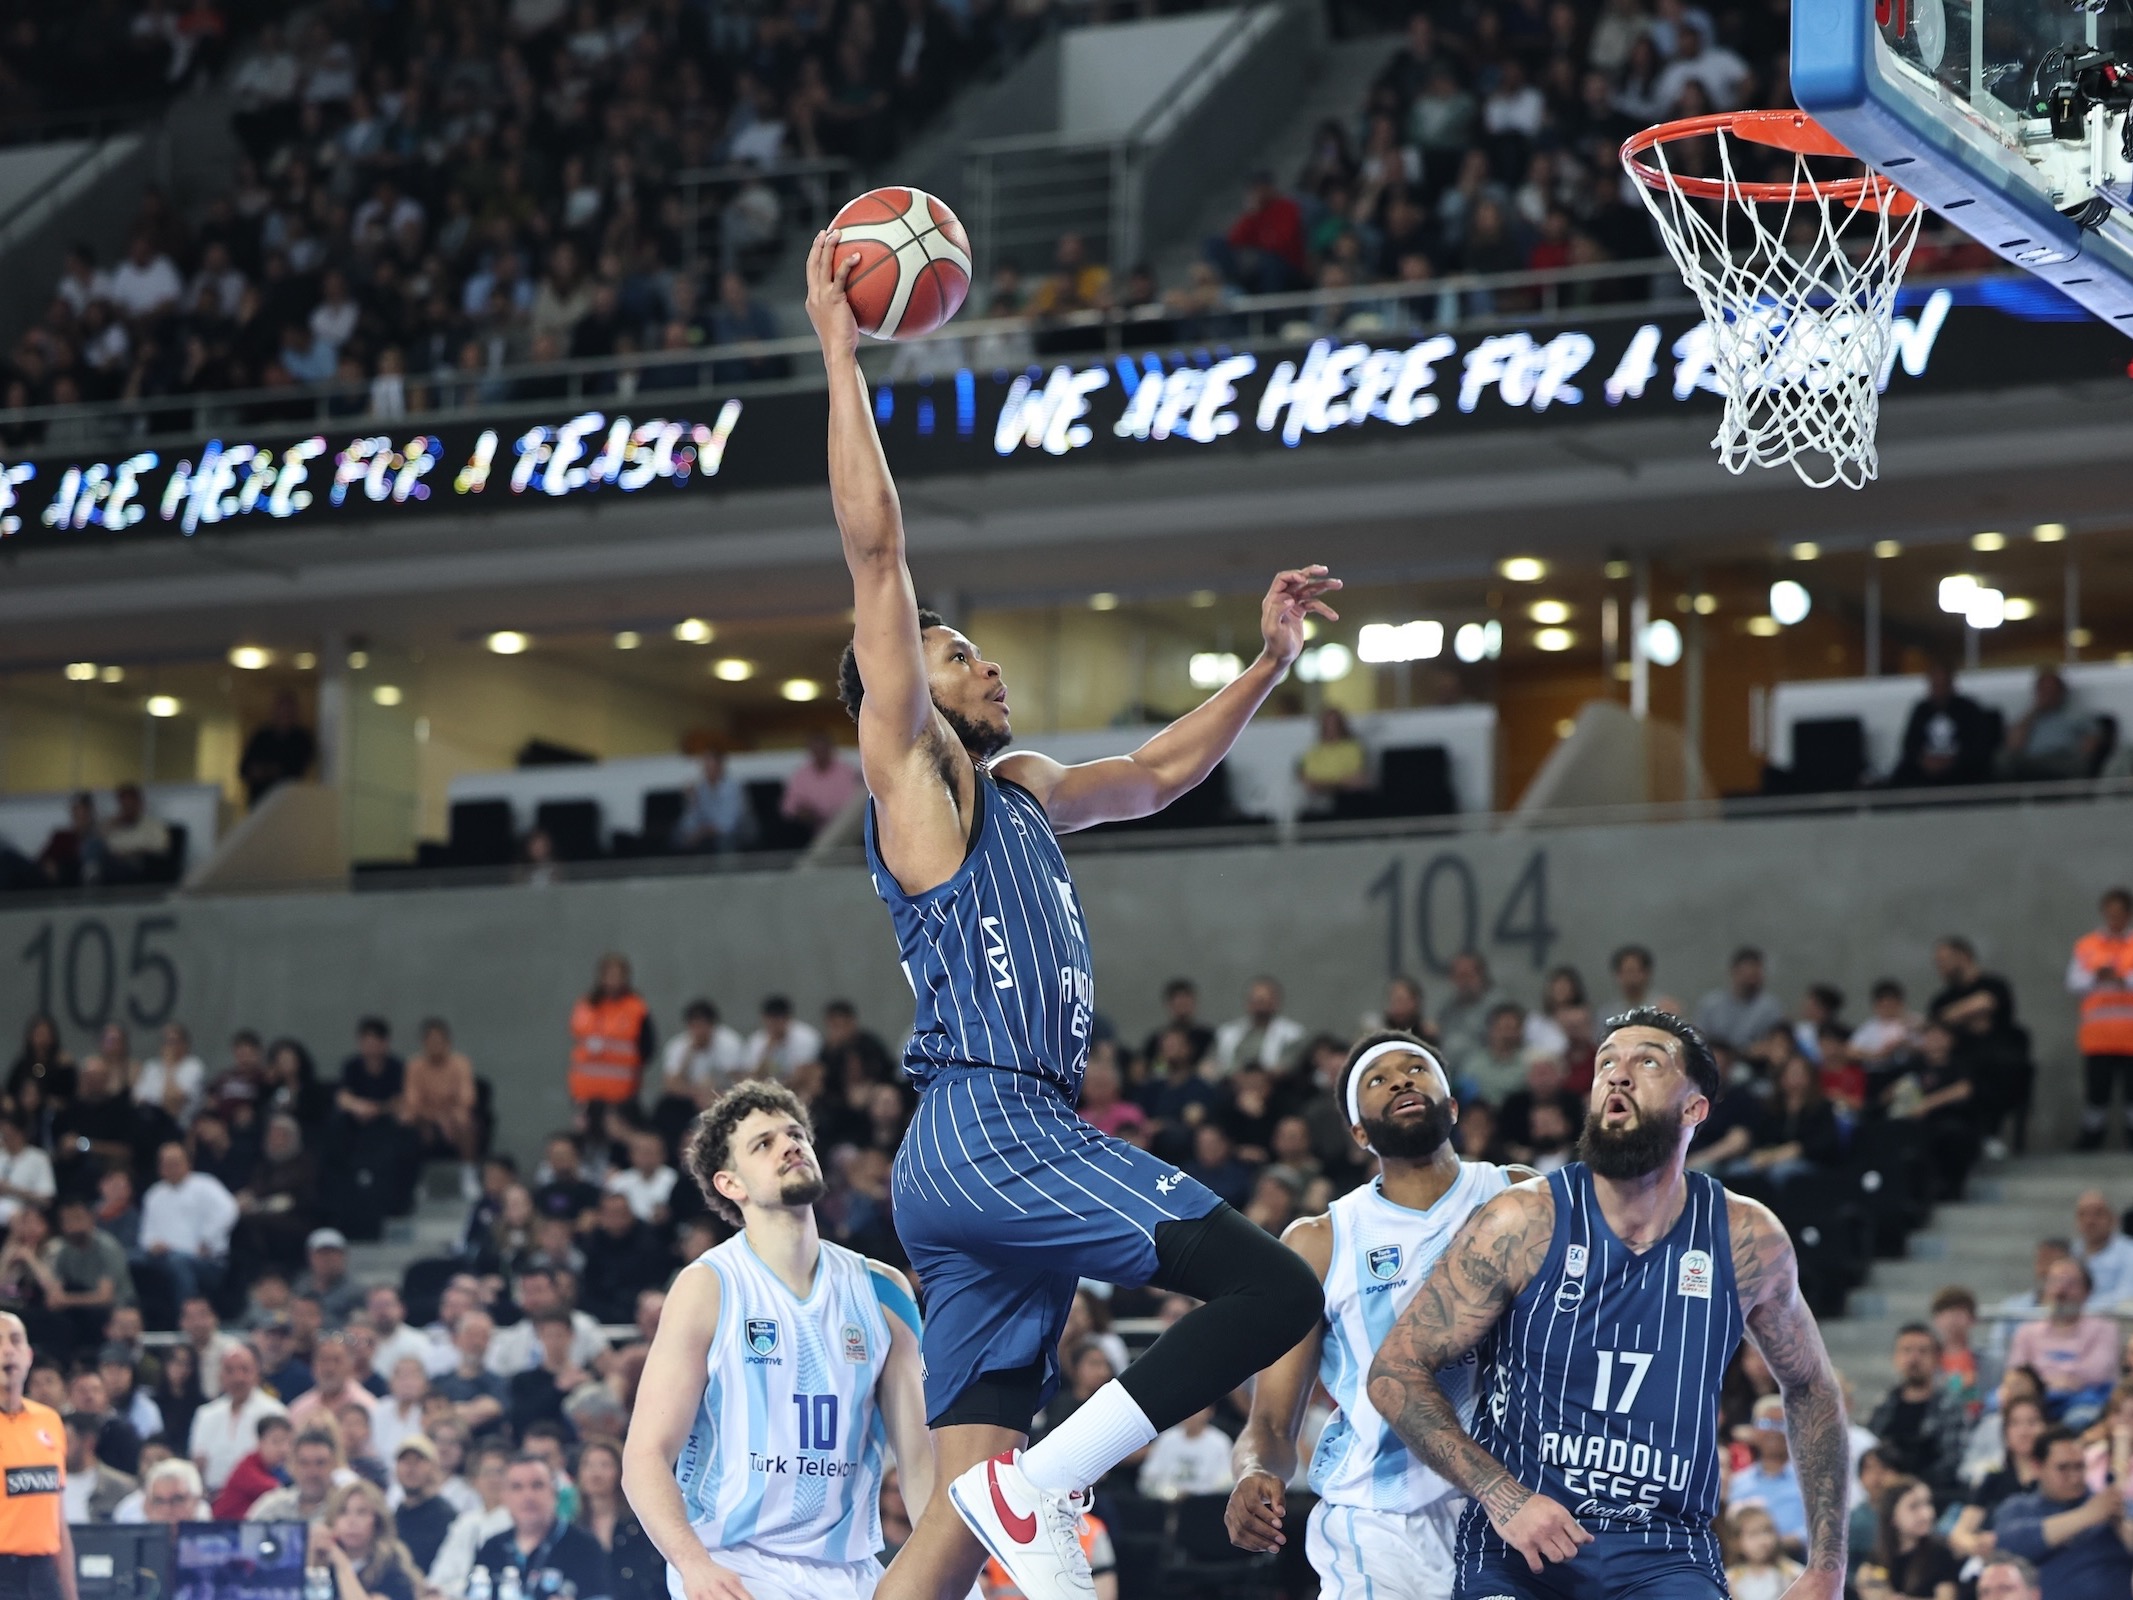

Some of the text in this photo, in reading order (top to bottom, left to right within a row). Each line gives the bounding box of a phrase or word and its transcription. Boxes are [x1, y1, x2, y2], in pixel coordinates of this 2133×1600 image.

[994, 365, 1109, 455] WE
[1256, 333, 1456, 447] HERE
[1458, 331, 1595, 413] FOR
[1604, 324, 1662, 407] A
[160, 435, 327, 536] HERE
[1365, 849, 1559, 979] 104
[23, 914, 180, 1031] 105
[1592, 1350, 1654, 1414] 17
[793, 1394, 838, 1450] 10
[750, 1453, 788, 1473] Türk
[1542, 1432, 1690, 1491] ANADOLU
[1564, 1468, 1663, 1509] EFES
